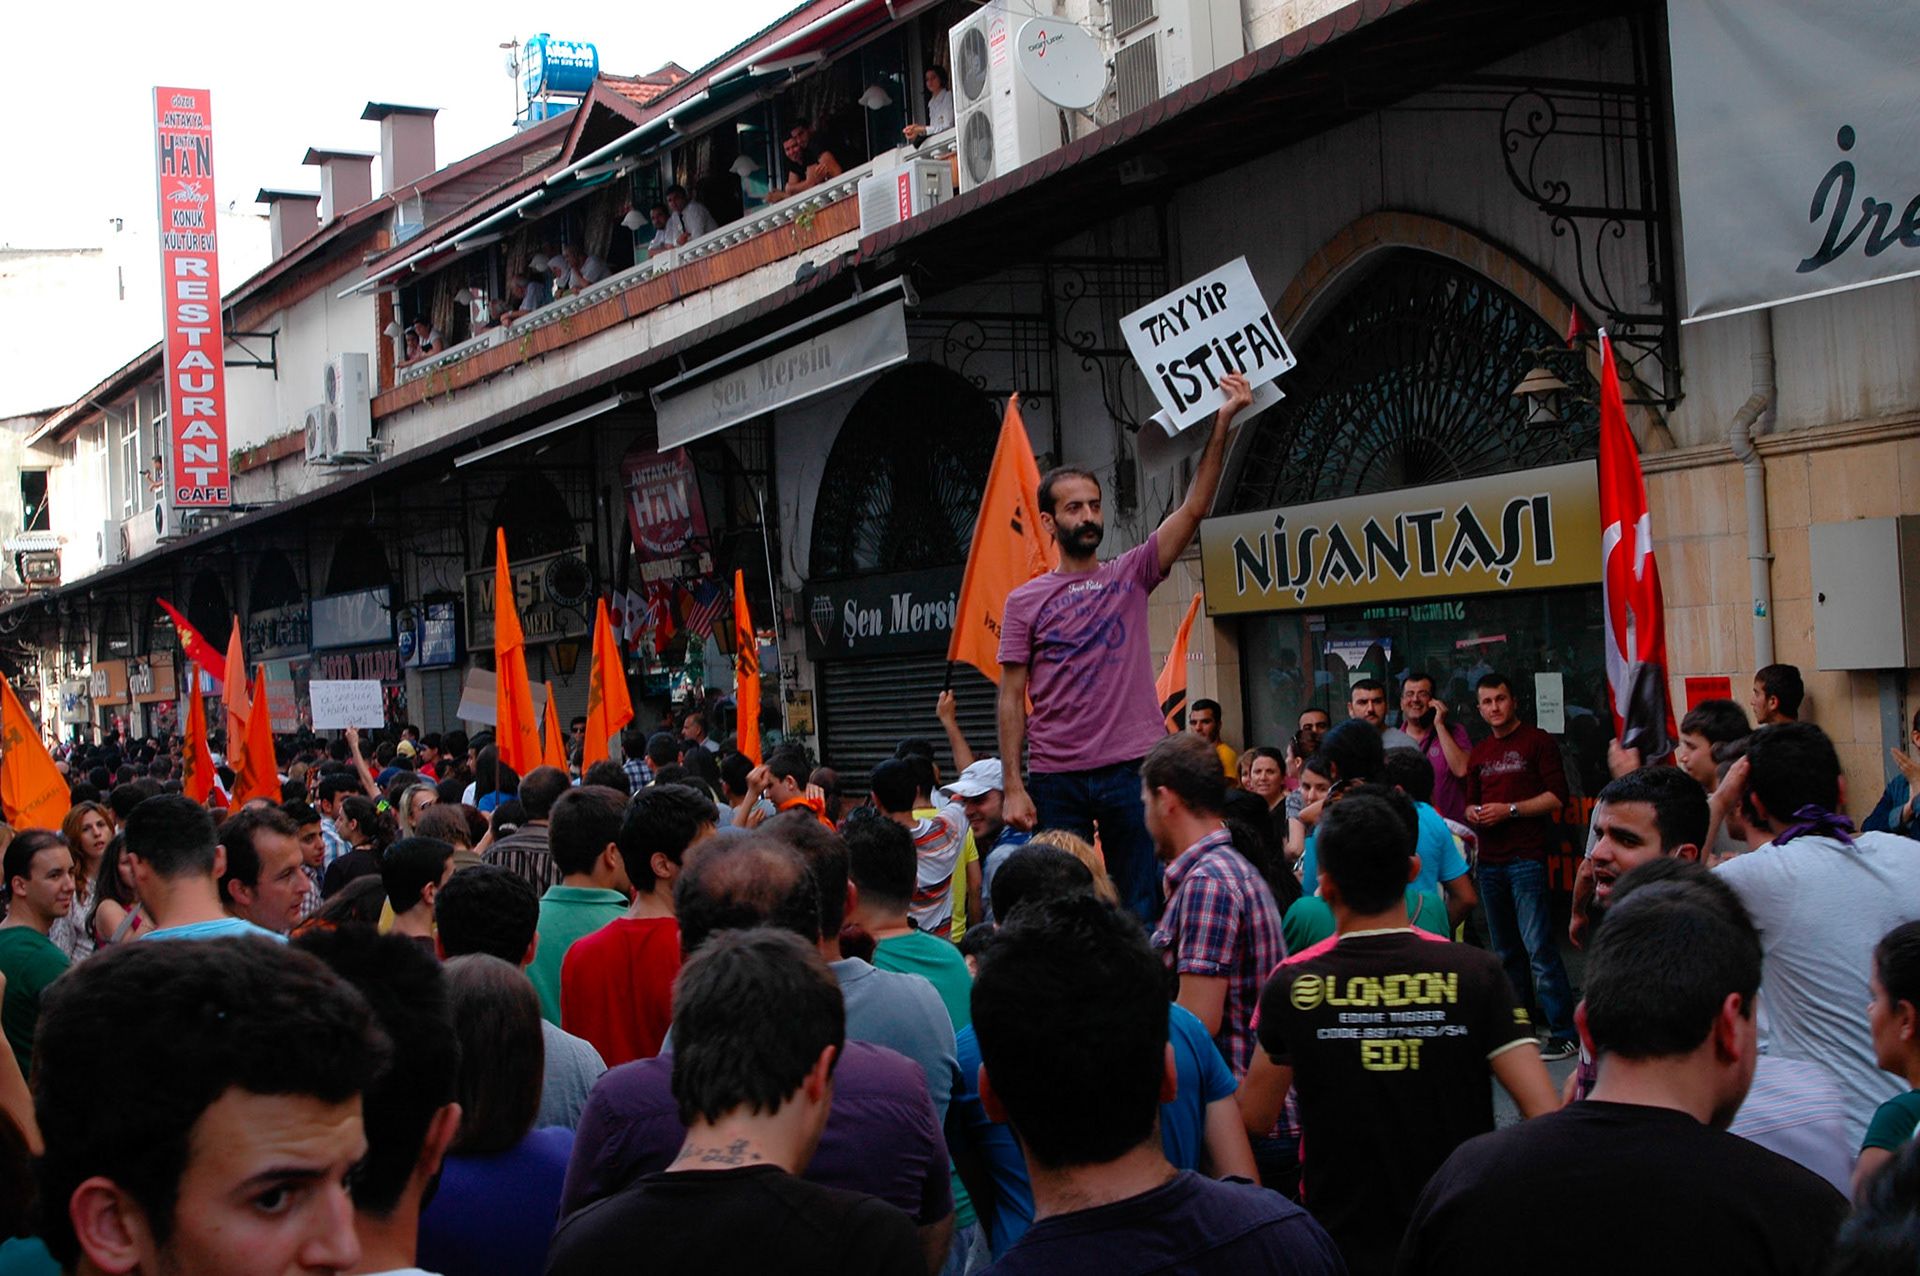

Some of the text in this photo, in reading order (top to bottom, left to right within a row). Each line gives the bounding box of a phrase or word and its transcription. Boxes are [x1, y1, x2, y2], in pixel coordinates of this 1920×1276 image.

[164, 111, 204, 127] ANTAKYA
[160, 133, 211, 178] HAN
[172, 209, 204, 228] KONUK
[163, 230, 199, 252] KÜLTÜR
[174, 257, 219, 486] RESTAURANT
[756, 338, 832, 395] Mersin
[630, 460, 679, 488] ANTAKYA
[177, 486, 229, 501] CAFE
[631, 479, 690, 529] HAN
[1233, 492, 1555, 604] NİŞANTAŞI
[842, 591, 959, 649] Şen Mersi
[320, 650, 399, 681] FOTO YILDIZ
[1325, 972, 1458, 1007] LONDON
[1361, 1038, 1424, 1072] EDT
